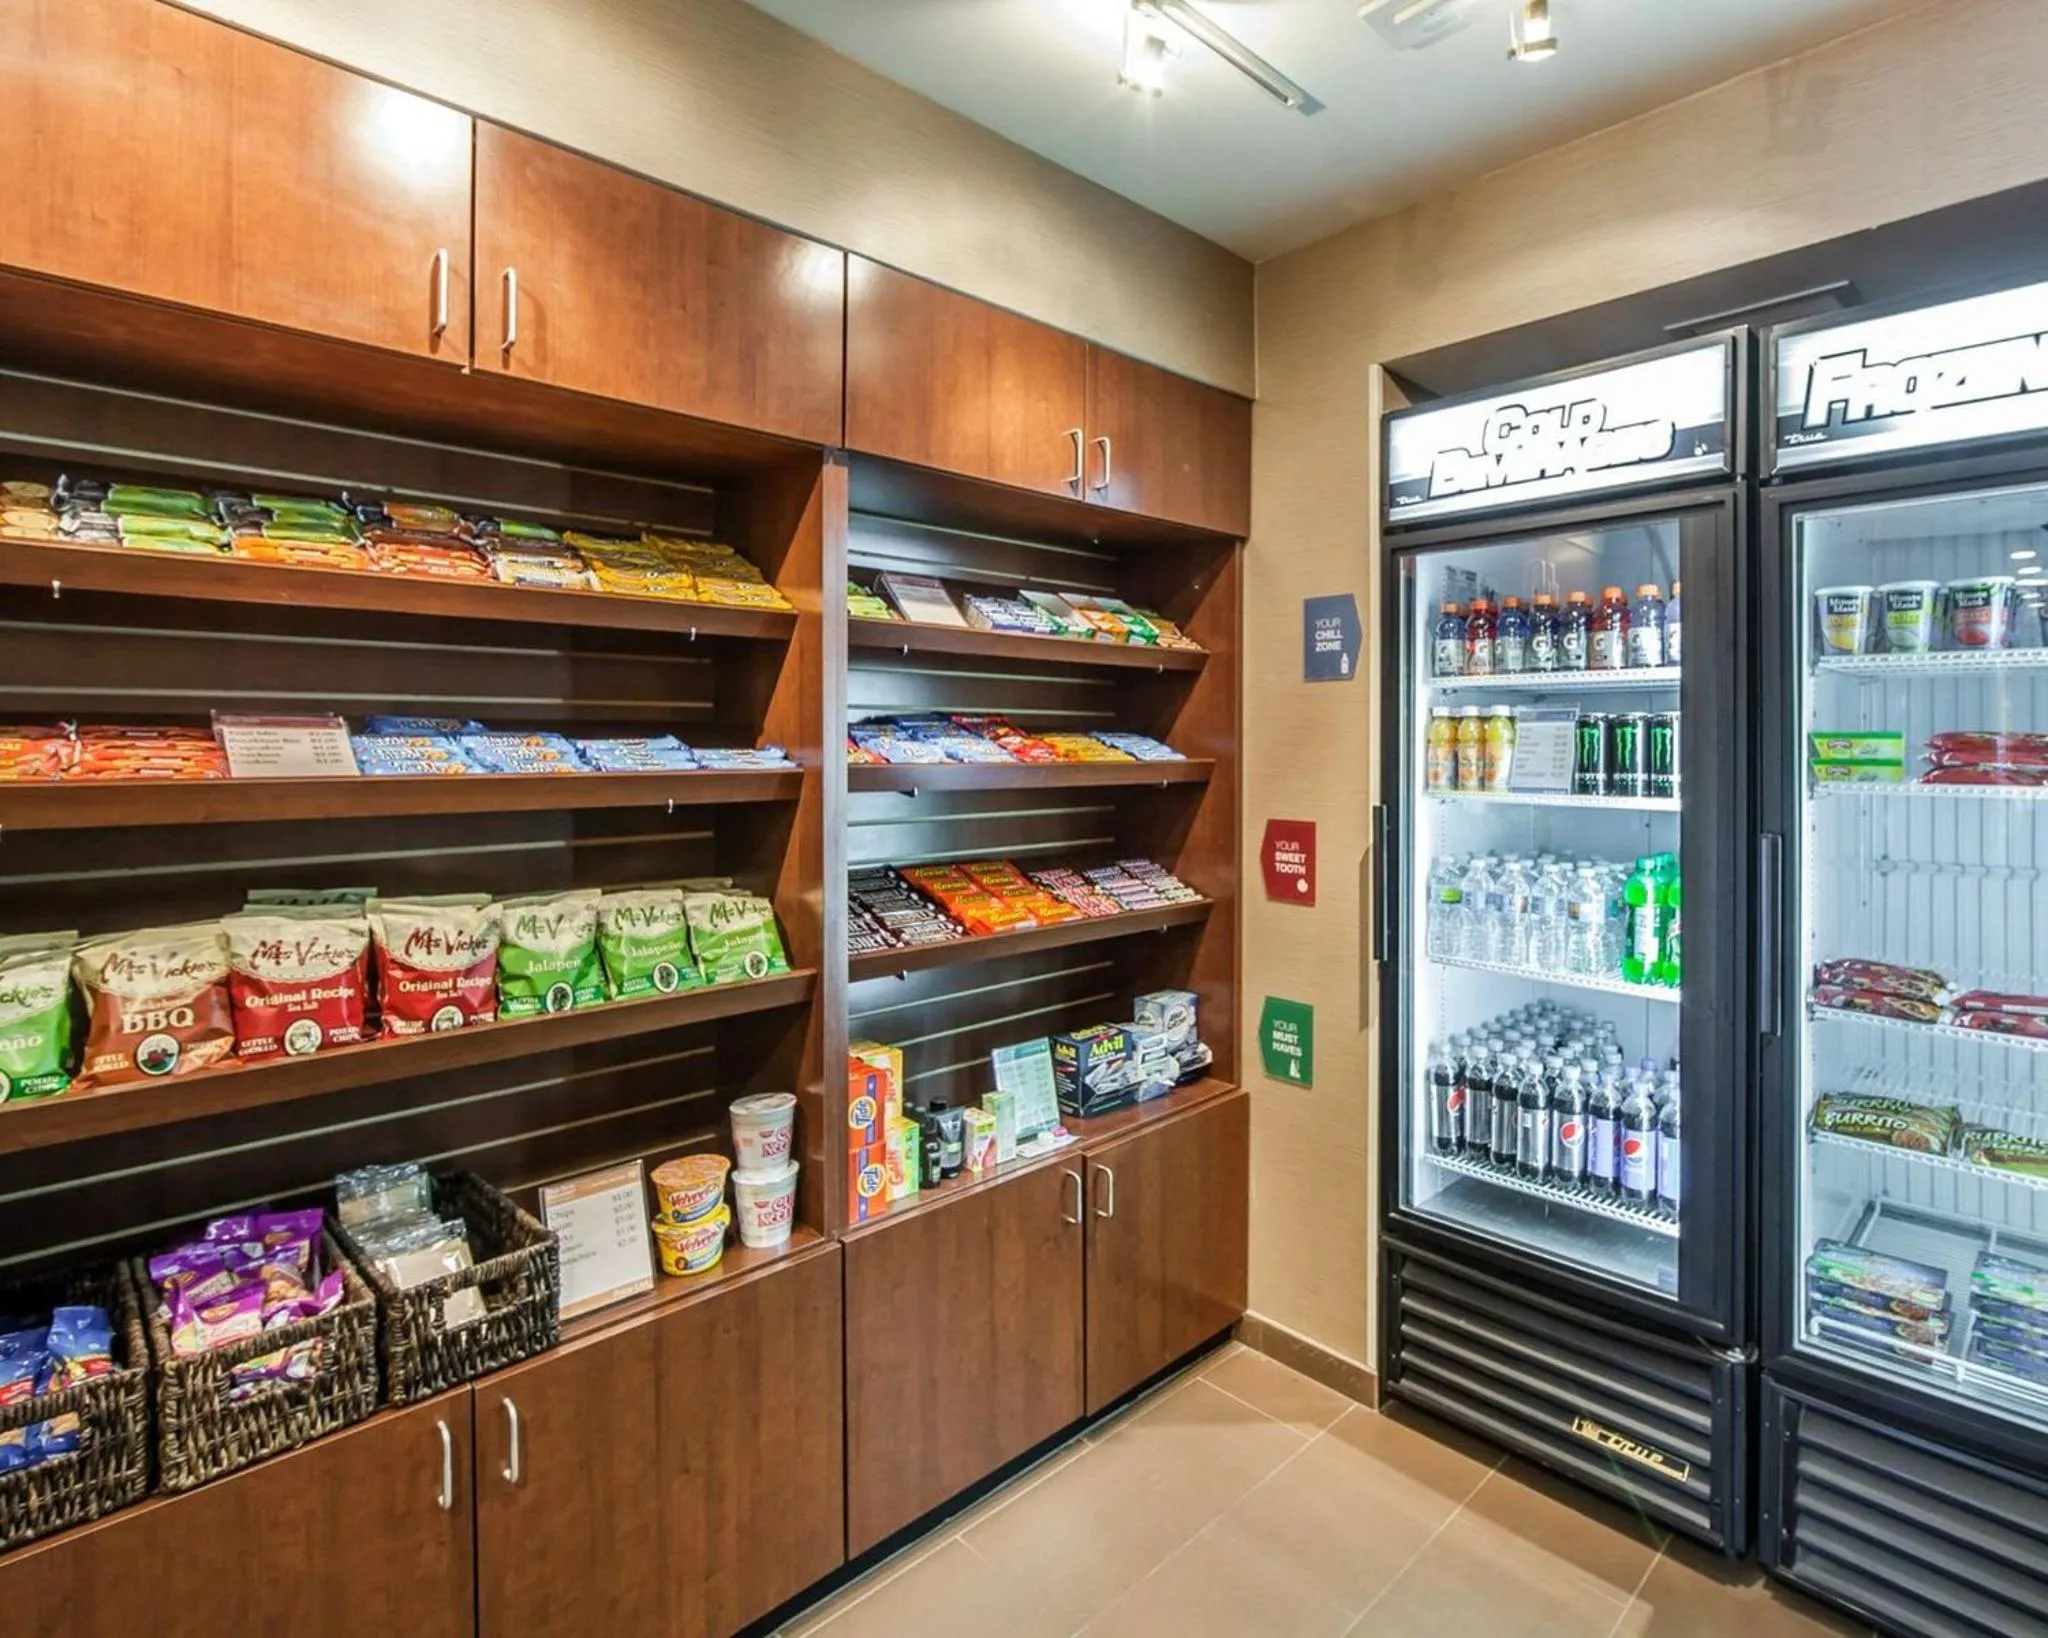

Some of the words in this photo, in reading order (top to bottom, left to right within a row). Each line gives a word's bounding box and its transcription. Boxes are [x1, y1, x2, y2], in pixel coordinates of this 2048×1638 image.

[1315, 617, 1341, 629] YOUR
[1315, 630, 1343, 641] CHILL
[1315, 641, 1341, 652] ZONE
[1274, 840, 1299, 851] YOUR
[1275, 851, 1306, 863] SWEET
[1274, 863, 1306, 875] TOOTH
[399, 978, 453, 992] Original
[245, 990, 308, 1008] Original
[310, 986, 356, 1001] Recipe
[121, 1007, 195, 1034] BBQ
[1272, 1018, 1298, 1034] YOUR
[1272, 1030, 1298, 1045] MUST
[1089, 1033, 1124, 1058] Advil
[1272, 1040, 1303, 1057] HAVES
